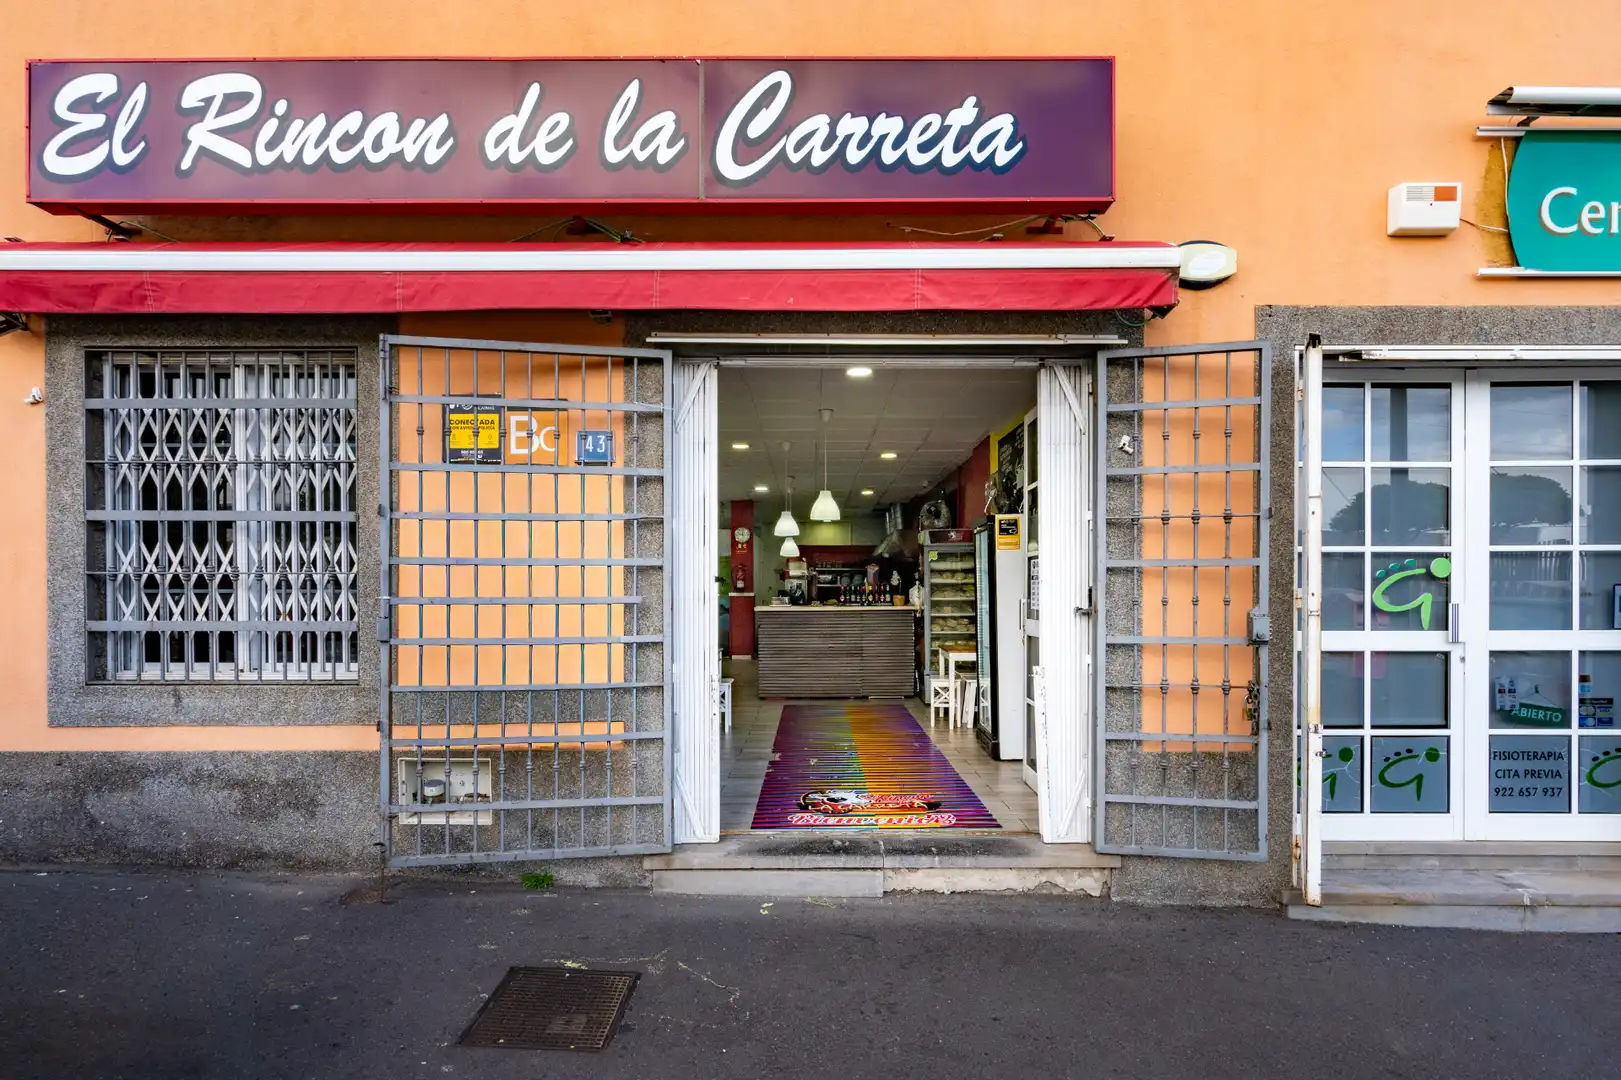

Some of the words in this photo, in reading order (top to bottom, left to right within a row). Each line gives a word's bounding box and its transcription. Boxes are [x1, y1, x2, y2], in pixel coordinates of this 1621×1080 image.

[43, 73, 148, 175] El
[180, 73, 454, 171] Rincon
[484, 82, 574, 165] de
[604, 78, 685, 165] la
[715, 70, 1023, 181] Carreta
[585, 435, 606, 453] 43
[1510, 707, 1562, 722] ABIERTO
[1493, 751, 1564, 761] FISIOTERAPIA
[1495, 769, 1521, 779] CITA
[1524, 769, 1562, 779] PREVIA
[1494, 787, 1514, 797] 922
[1518, 787, 1538, 797] 657
[1542, 787, 1562, 797] 937
